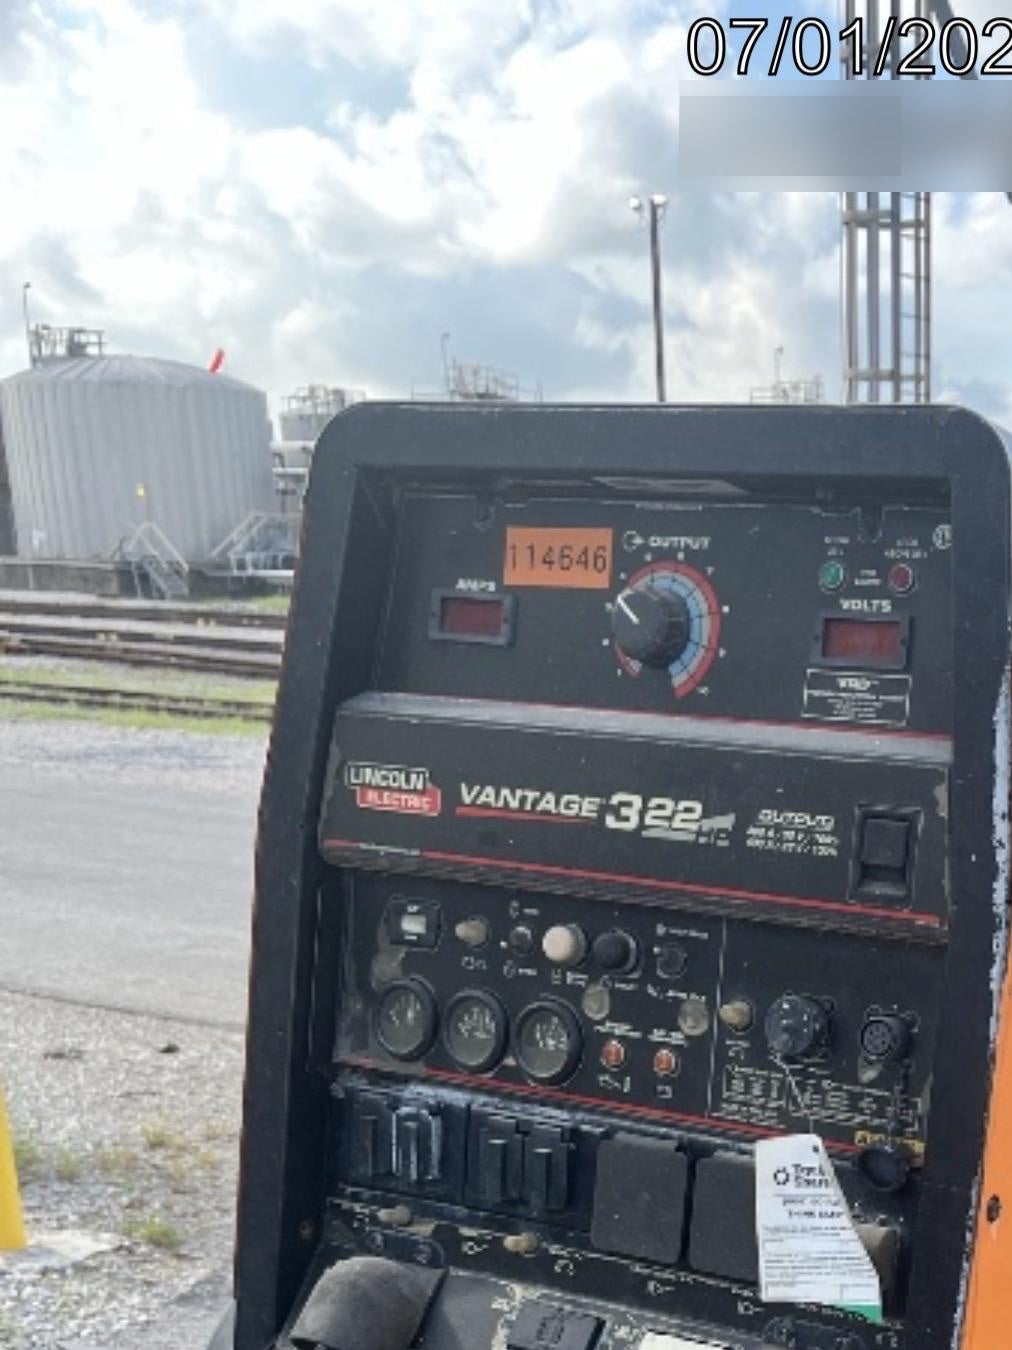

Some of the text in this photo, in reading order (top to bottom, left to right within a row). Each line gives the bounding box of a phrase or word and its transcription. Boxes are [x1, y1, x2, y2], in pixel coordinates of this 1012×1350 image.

[649, 535, 712, 550] OUTPUT
[508, 542, 608, 575] 114646
[839, 598, 893, 614] VOLTS
[349, 766, 425, 790] LINCOLN
[366, 788, 433, 811] ELECTRIC
[459, 782, 703, 832] VANTAGE 322
